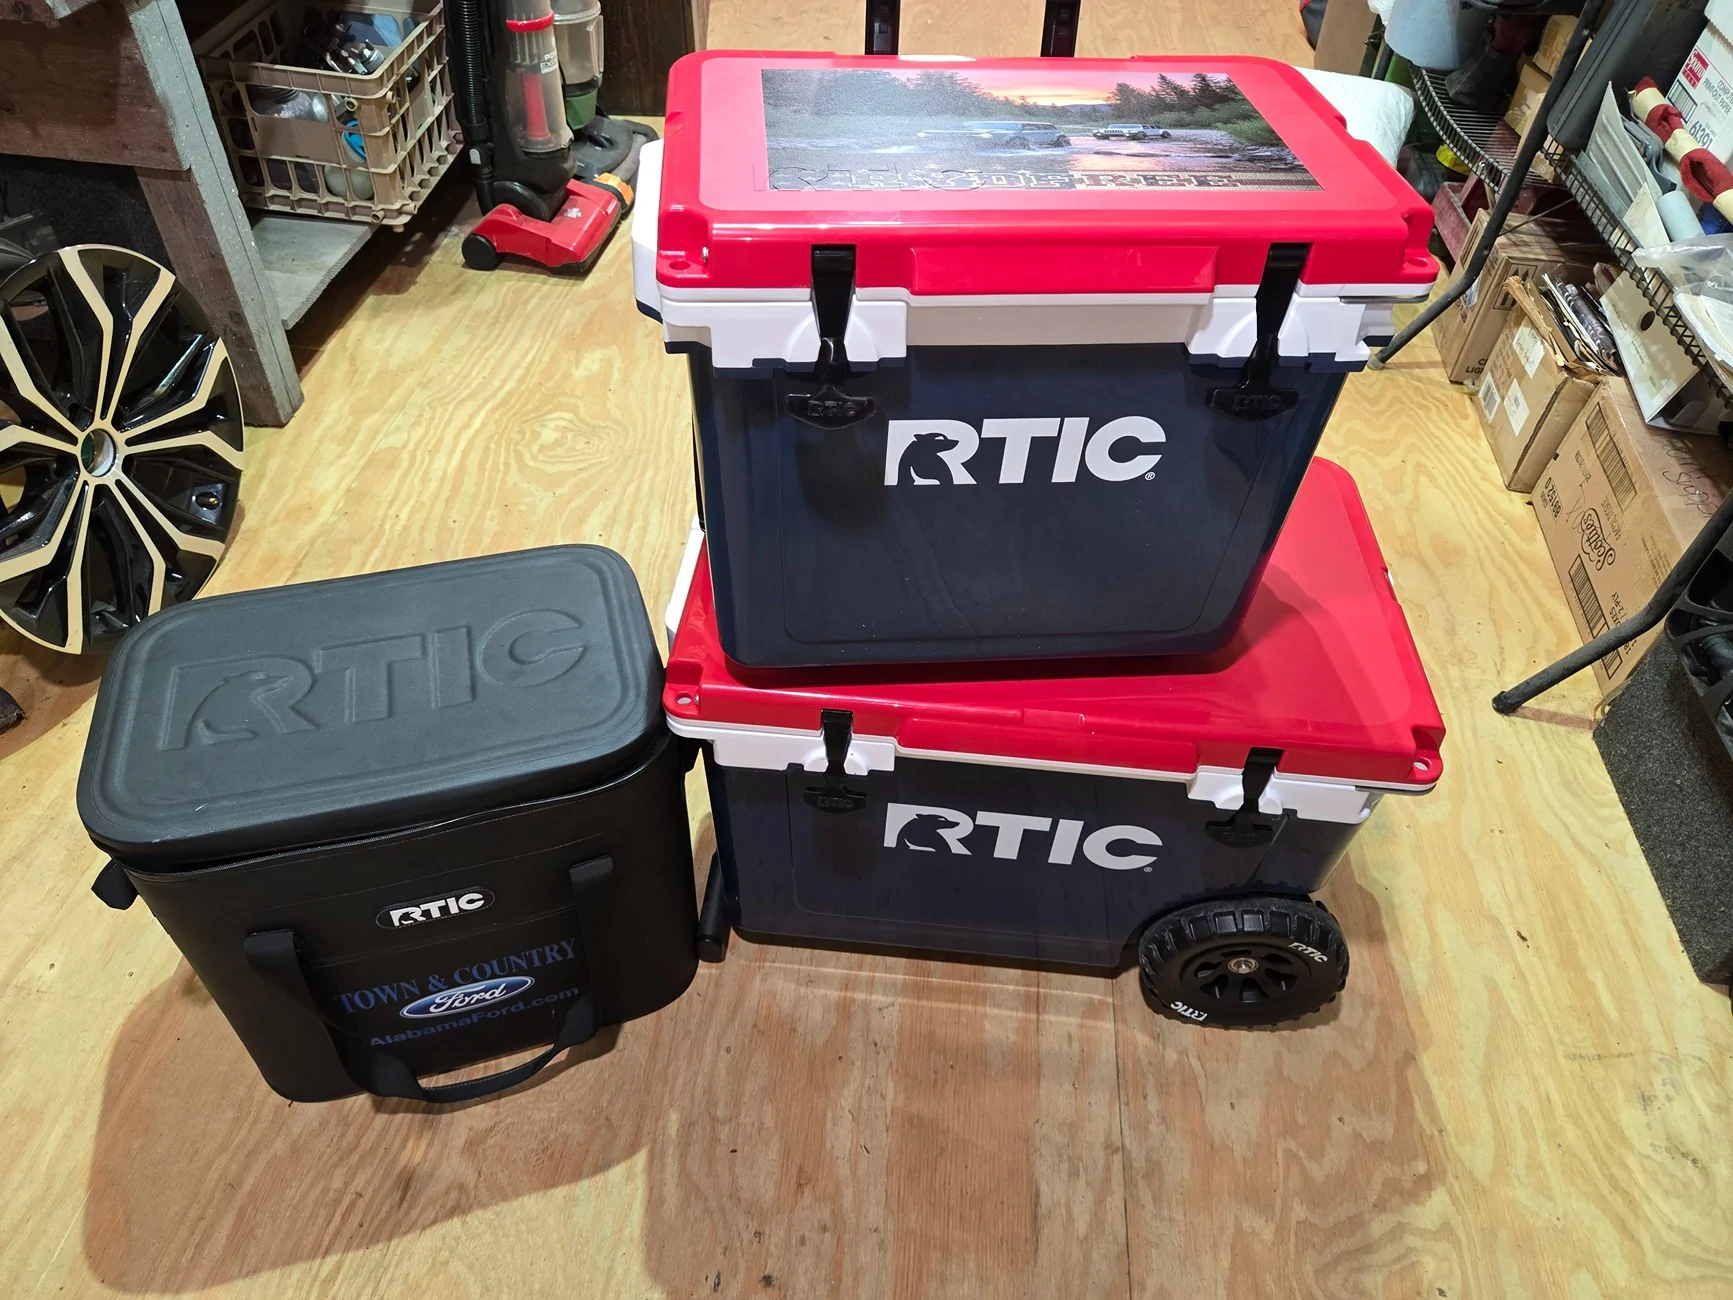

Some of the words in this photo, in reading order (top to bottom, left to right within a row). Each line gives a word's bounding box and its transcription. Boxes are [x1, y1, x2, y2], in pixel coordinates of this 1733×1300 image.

[1687, 50, 1706, 78] Sparco
[1717, 80, 1733, 107] COMPUTE
[884, 416, 1166, 486] RTIC
[1583, 513, 1617, 571] Scotties
[162, 609, 586, 751] RTIC
[884, 803, 1163, 870] RTIC
[389, 892, 485, 927] RTIC
[1288, 942, 1328, 963] RTIC
[335, 979, 421, 1015] TOWN
[428, 973, 448, 993] &
[454, 937, 576, 985] COUNTRY
[429, 983, 507, 1013] Ford
[370, 986, 579, 1047] AlabamaFord.com
[1170, 1001, 1208, 1022] RTIC
